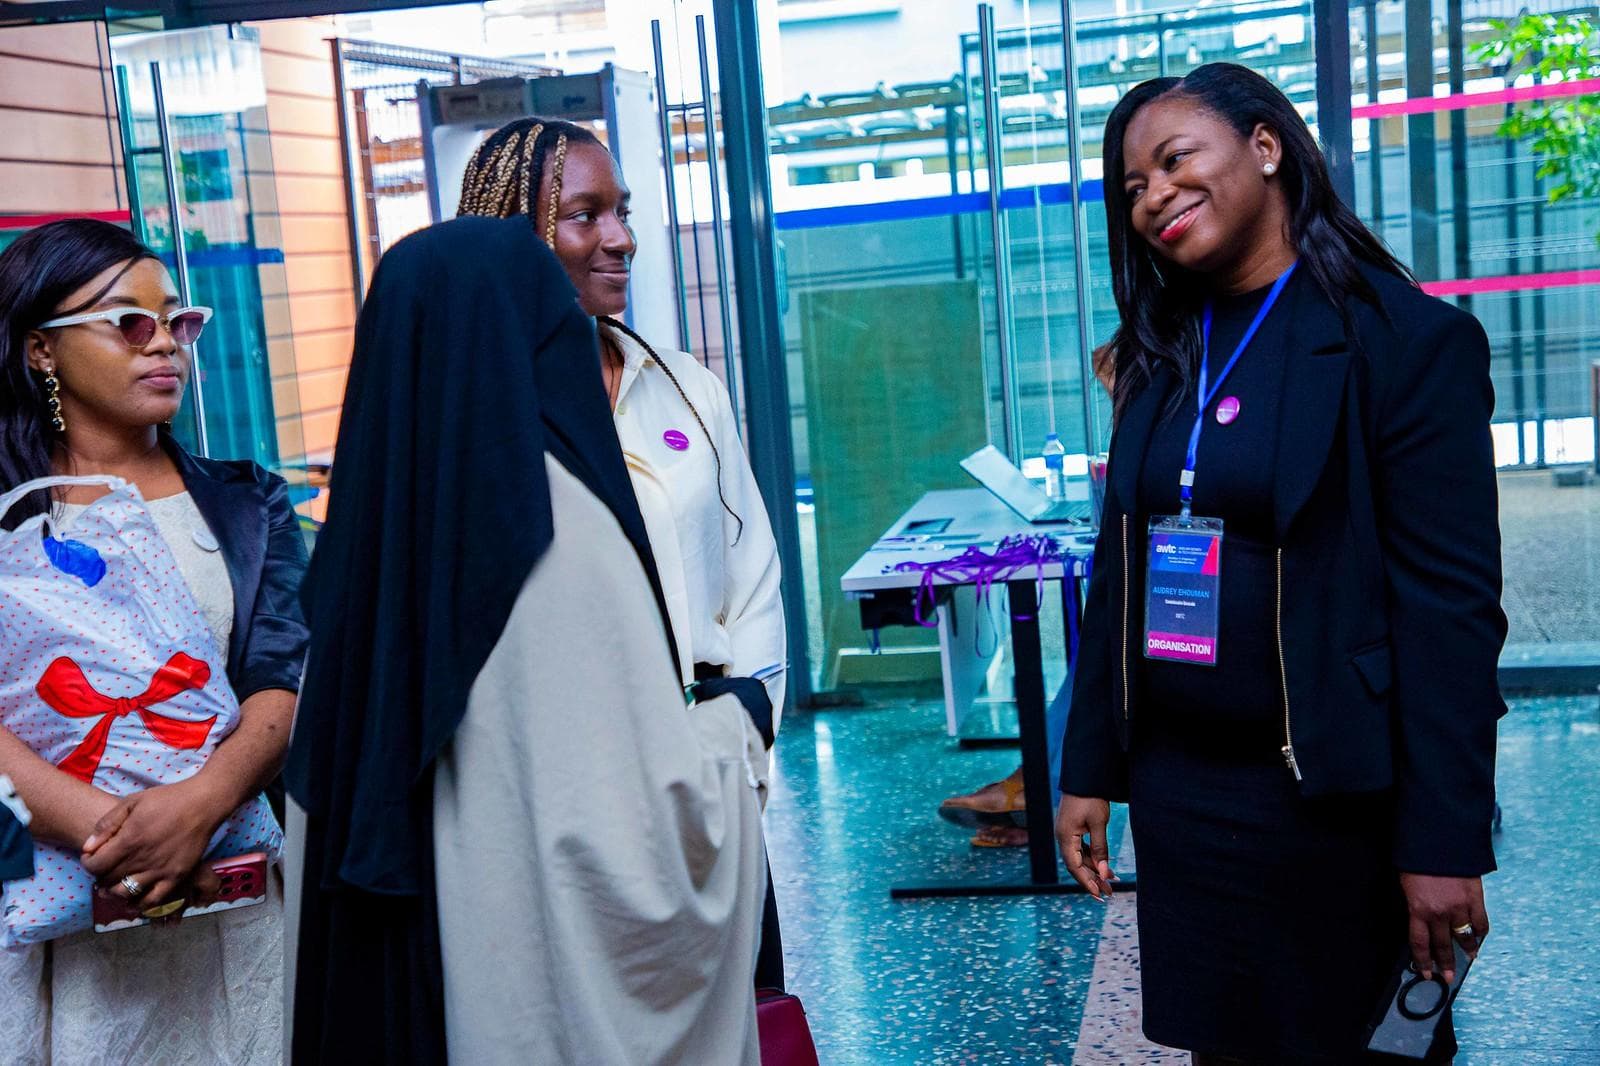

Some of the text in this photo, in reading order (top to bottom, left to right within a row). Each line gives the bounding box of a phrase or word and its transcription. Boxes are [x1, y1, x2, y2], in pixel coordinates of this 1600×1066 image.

[1156, 544, 1176, 554] awtc
[1153, 586, 1210, 599] AUDREY EHOUMAN
[1148, 639, 1211, 655] ORGANISATION
